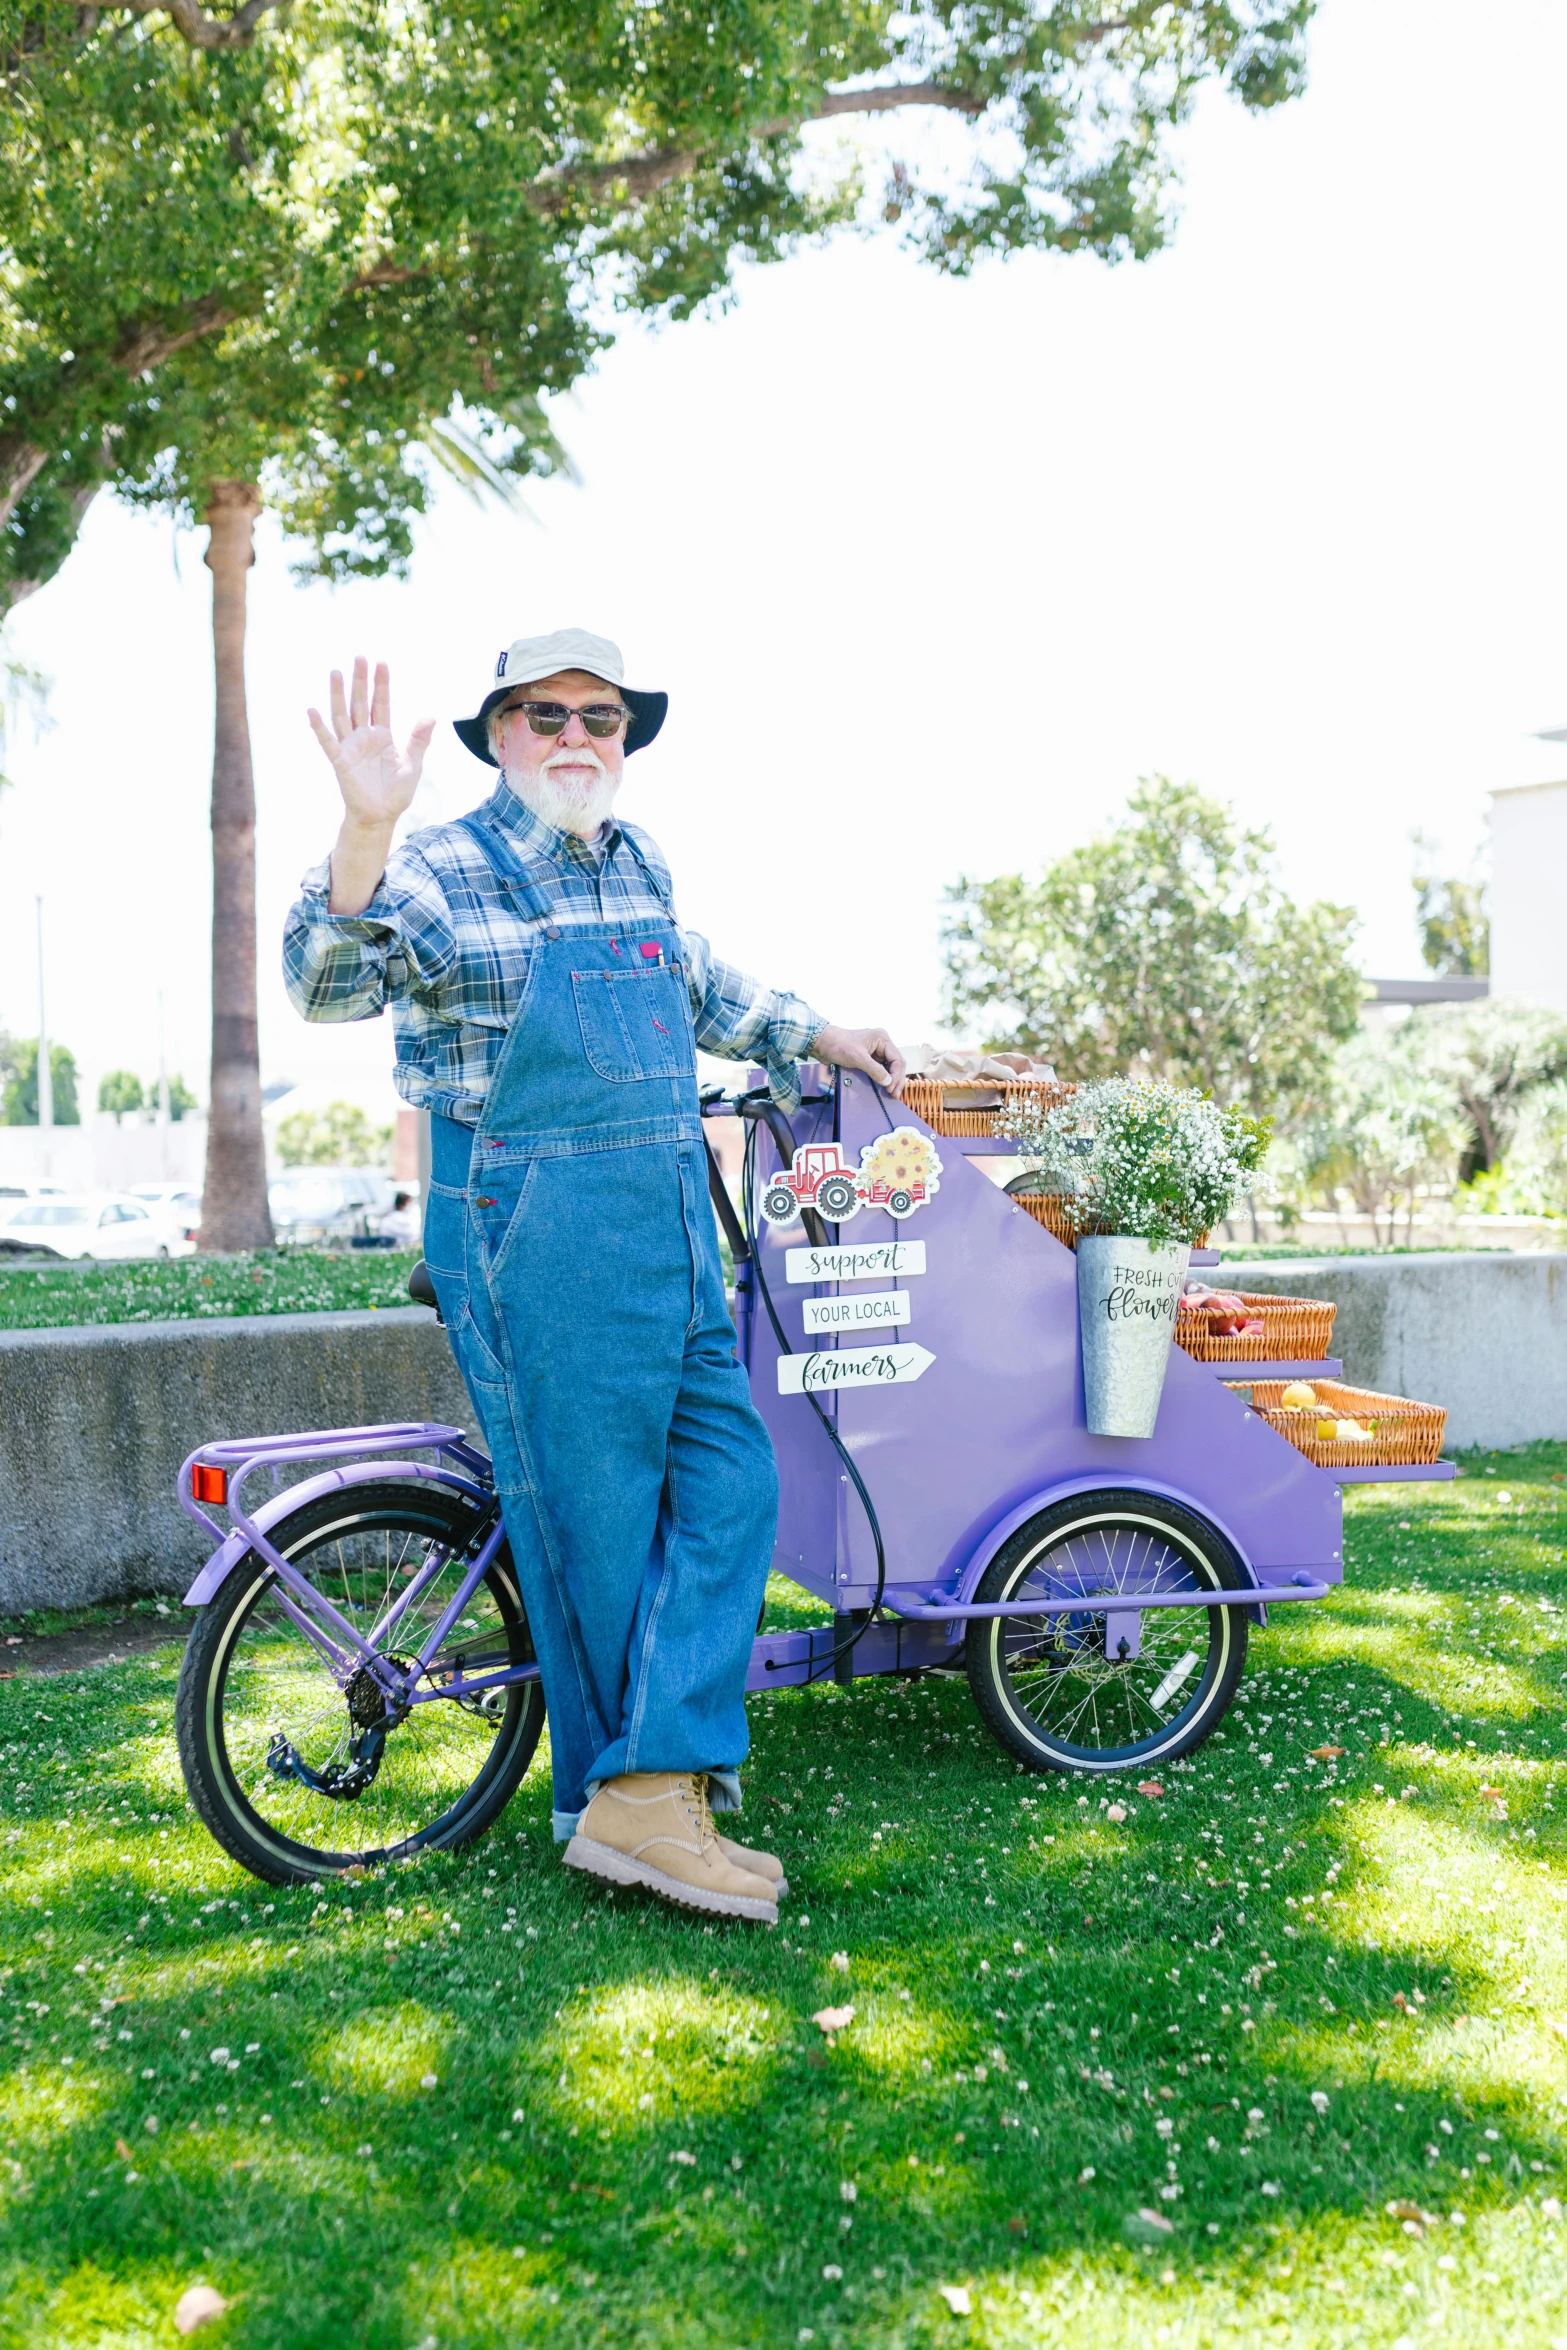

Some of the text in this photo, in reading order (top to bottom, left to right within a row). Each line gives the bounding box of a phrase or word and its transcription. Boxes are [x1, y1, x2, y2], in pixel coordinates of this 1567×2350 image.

[805, 1243, 906, 1277] support
[811, 1300, 900, 1324] YOUR LOCAL
[802, 1352, 914, 1392] farmers
